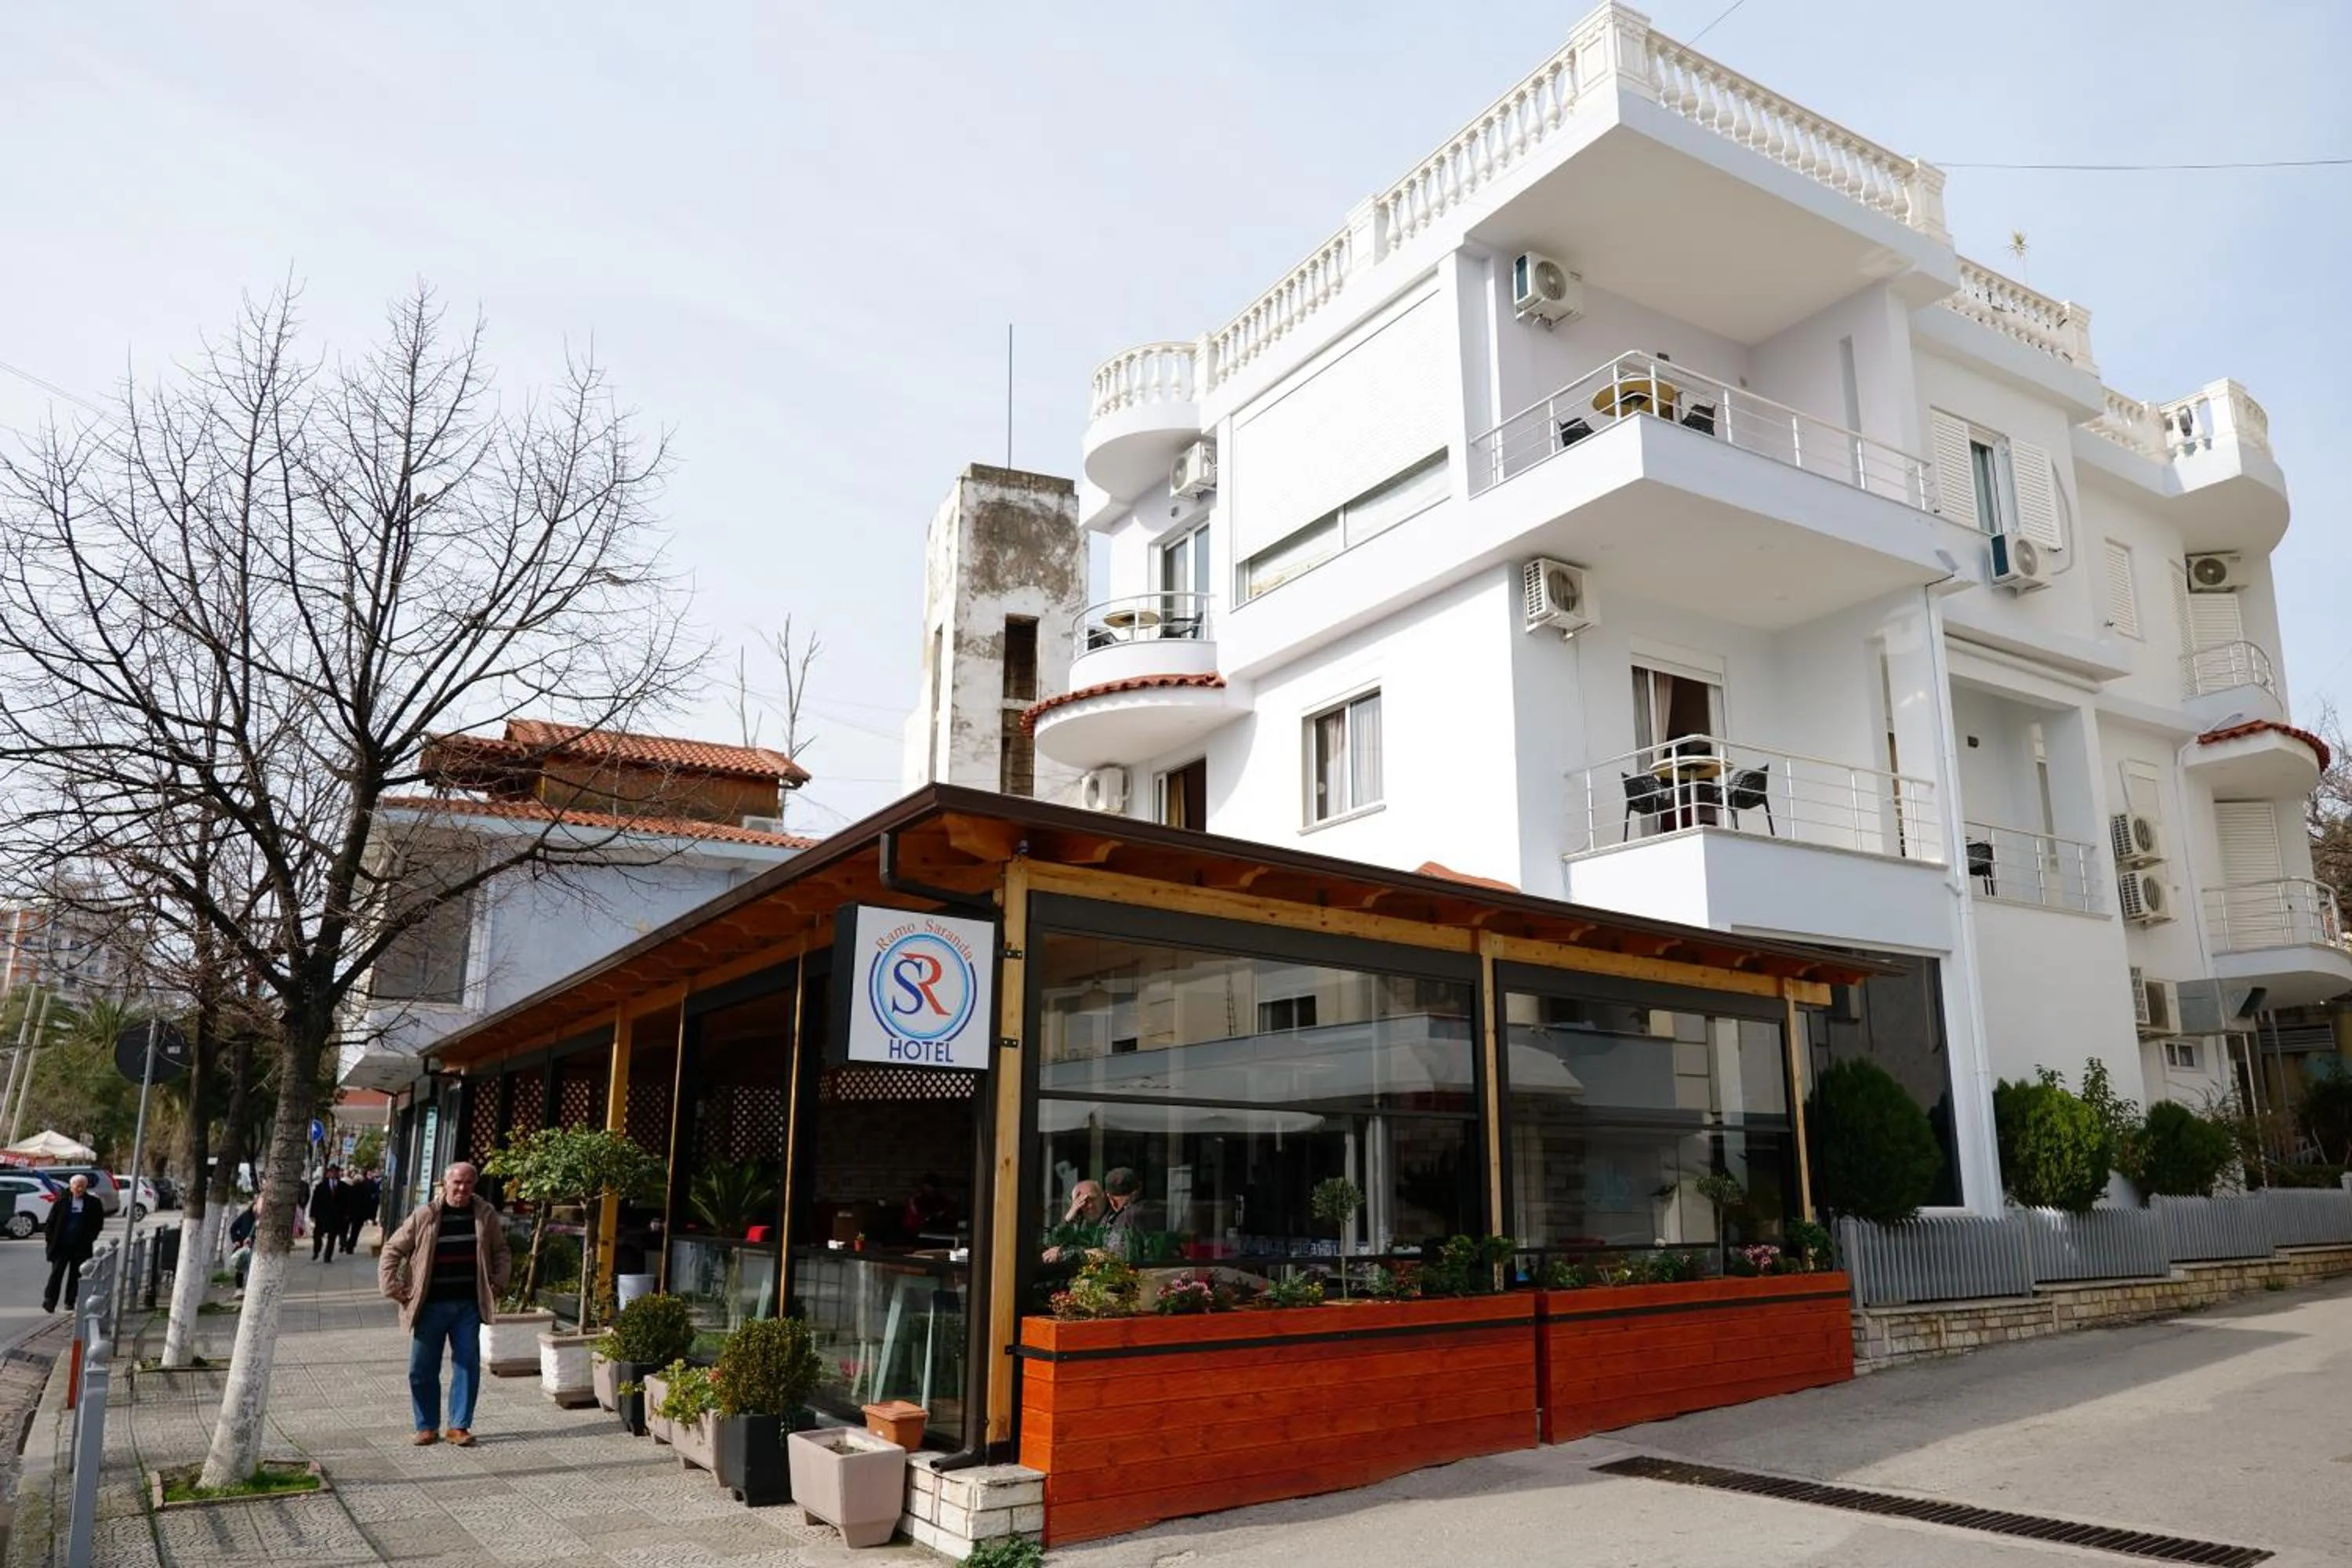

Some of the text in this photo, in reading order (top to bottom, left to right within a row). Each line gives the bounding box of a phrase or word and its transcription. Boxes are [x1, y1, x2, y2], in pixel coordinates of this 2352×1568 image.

[876, 919, 973, 960] Ramo Saranda
[889, 1040, 953, 1062] HOTEL
